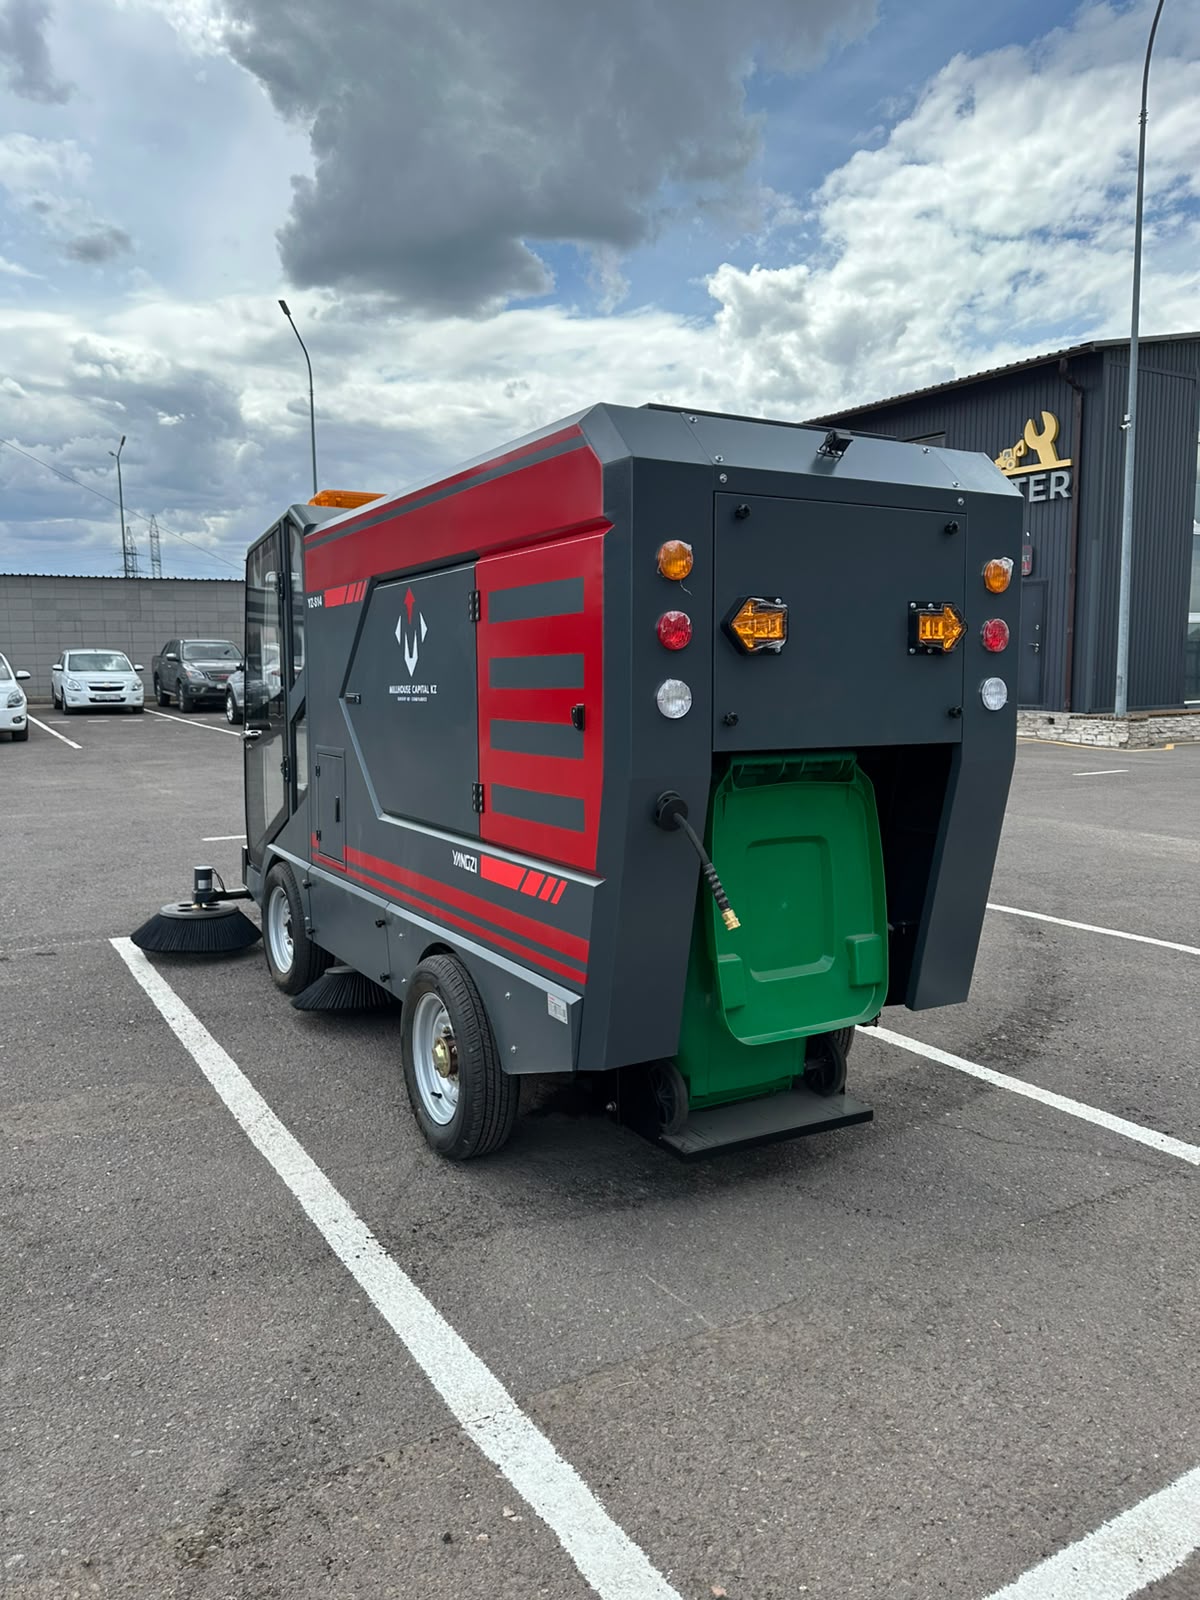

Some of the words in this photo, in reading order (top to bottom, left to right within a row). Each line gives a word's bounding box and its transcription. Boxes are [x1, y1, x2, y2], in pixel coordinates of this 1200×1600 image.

[412, 685, 429, 694] CAPITAL
[430, 685, 437, 694] KZ
[452, 850, 477, 873] YANGZI
